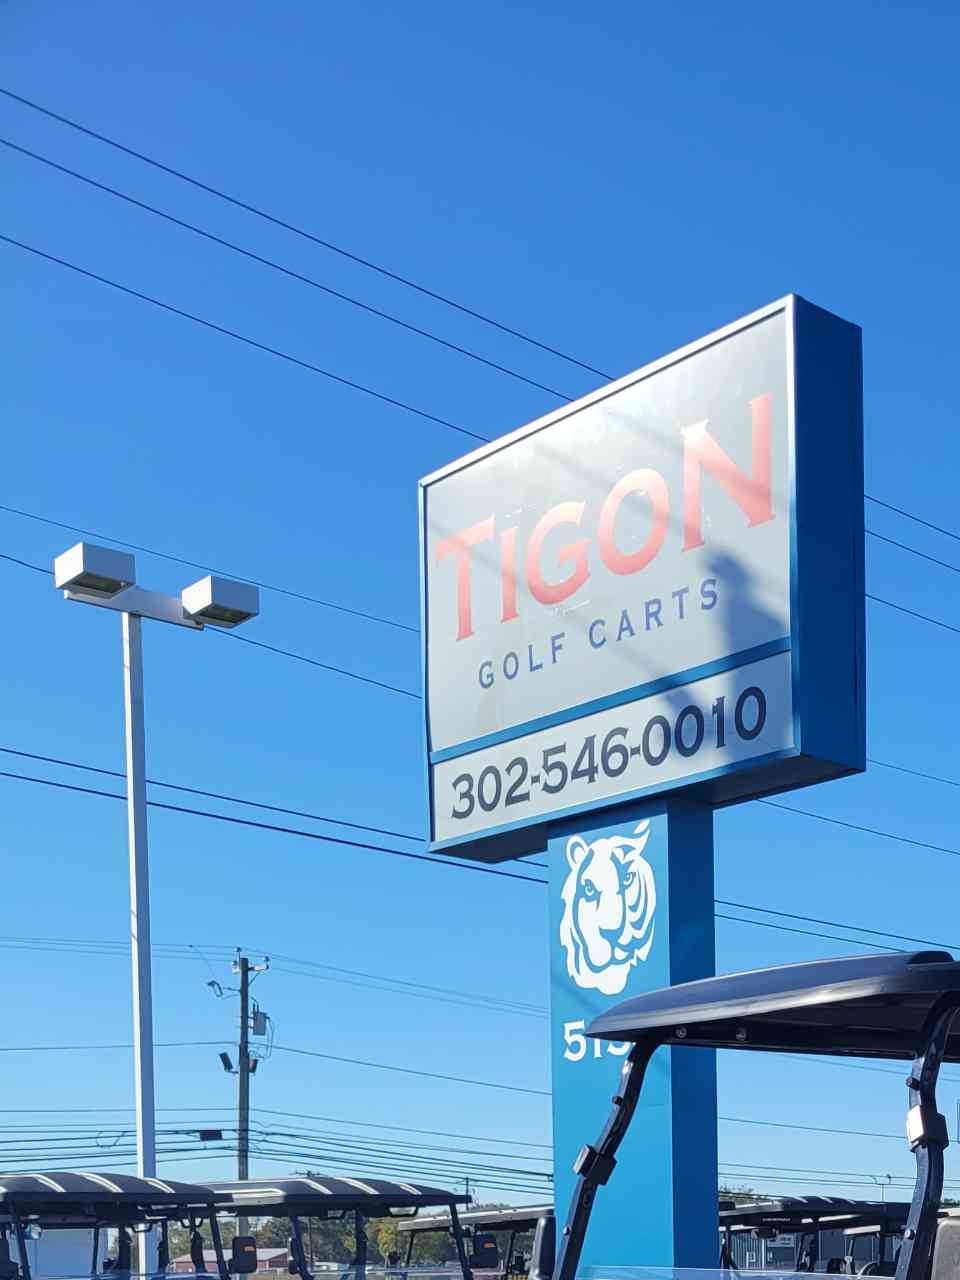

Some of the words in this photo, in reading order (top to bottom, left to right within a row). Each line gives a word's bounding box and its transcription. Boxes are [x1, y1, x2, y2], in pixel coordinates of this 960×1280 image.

[435, 392, 776, 642] TIGON
[479, 632, 567, 690] GOLF
[589, 578, 719, 650] CARTS
[451, 686, 767, 820] 302-546-0010
